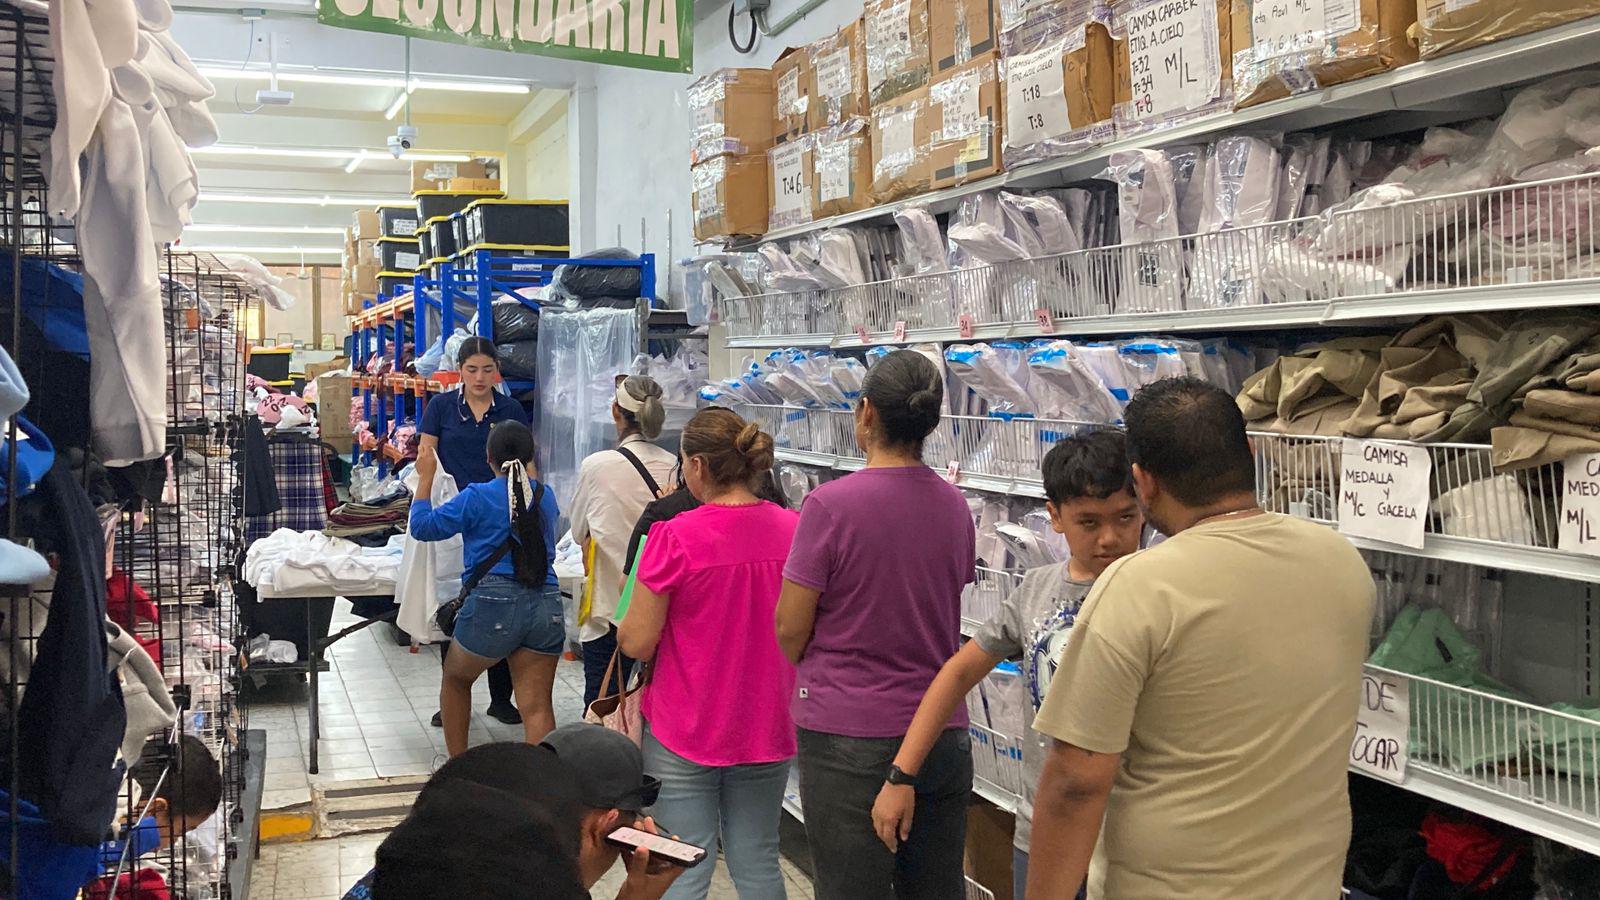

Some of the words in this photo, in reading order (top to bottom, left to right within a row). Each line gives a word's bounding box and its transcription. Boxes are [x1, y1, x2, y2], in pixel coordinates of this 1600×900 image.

[1129, 9, 1158, 35] CAMISA
[1158, 0, 1198, 22] CARBER
[1164, 47, 1198, 89] M/L
[1021, 83, 1041, 103] T:18
[1027, 113, 1044, 130] T:8
[1363, 445, 1409, 468] CAMISA
[1345, 468, 1394, 485] MEDALLA
[1377, 501, 1418, 520] GACELA
[1566, 507, 1597, 545] M/L
[1361, 676, 1397, 714] DE
